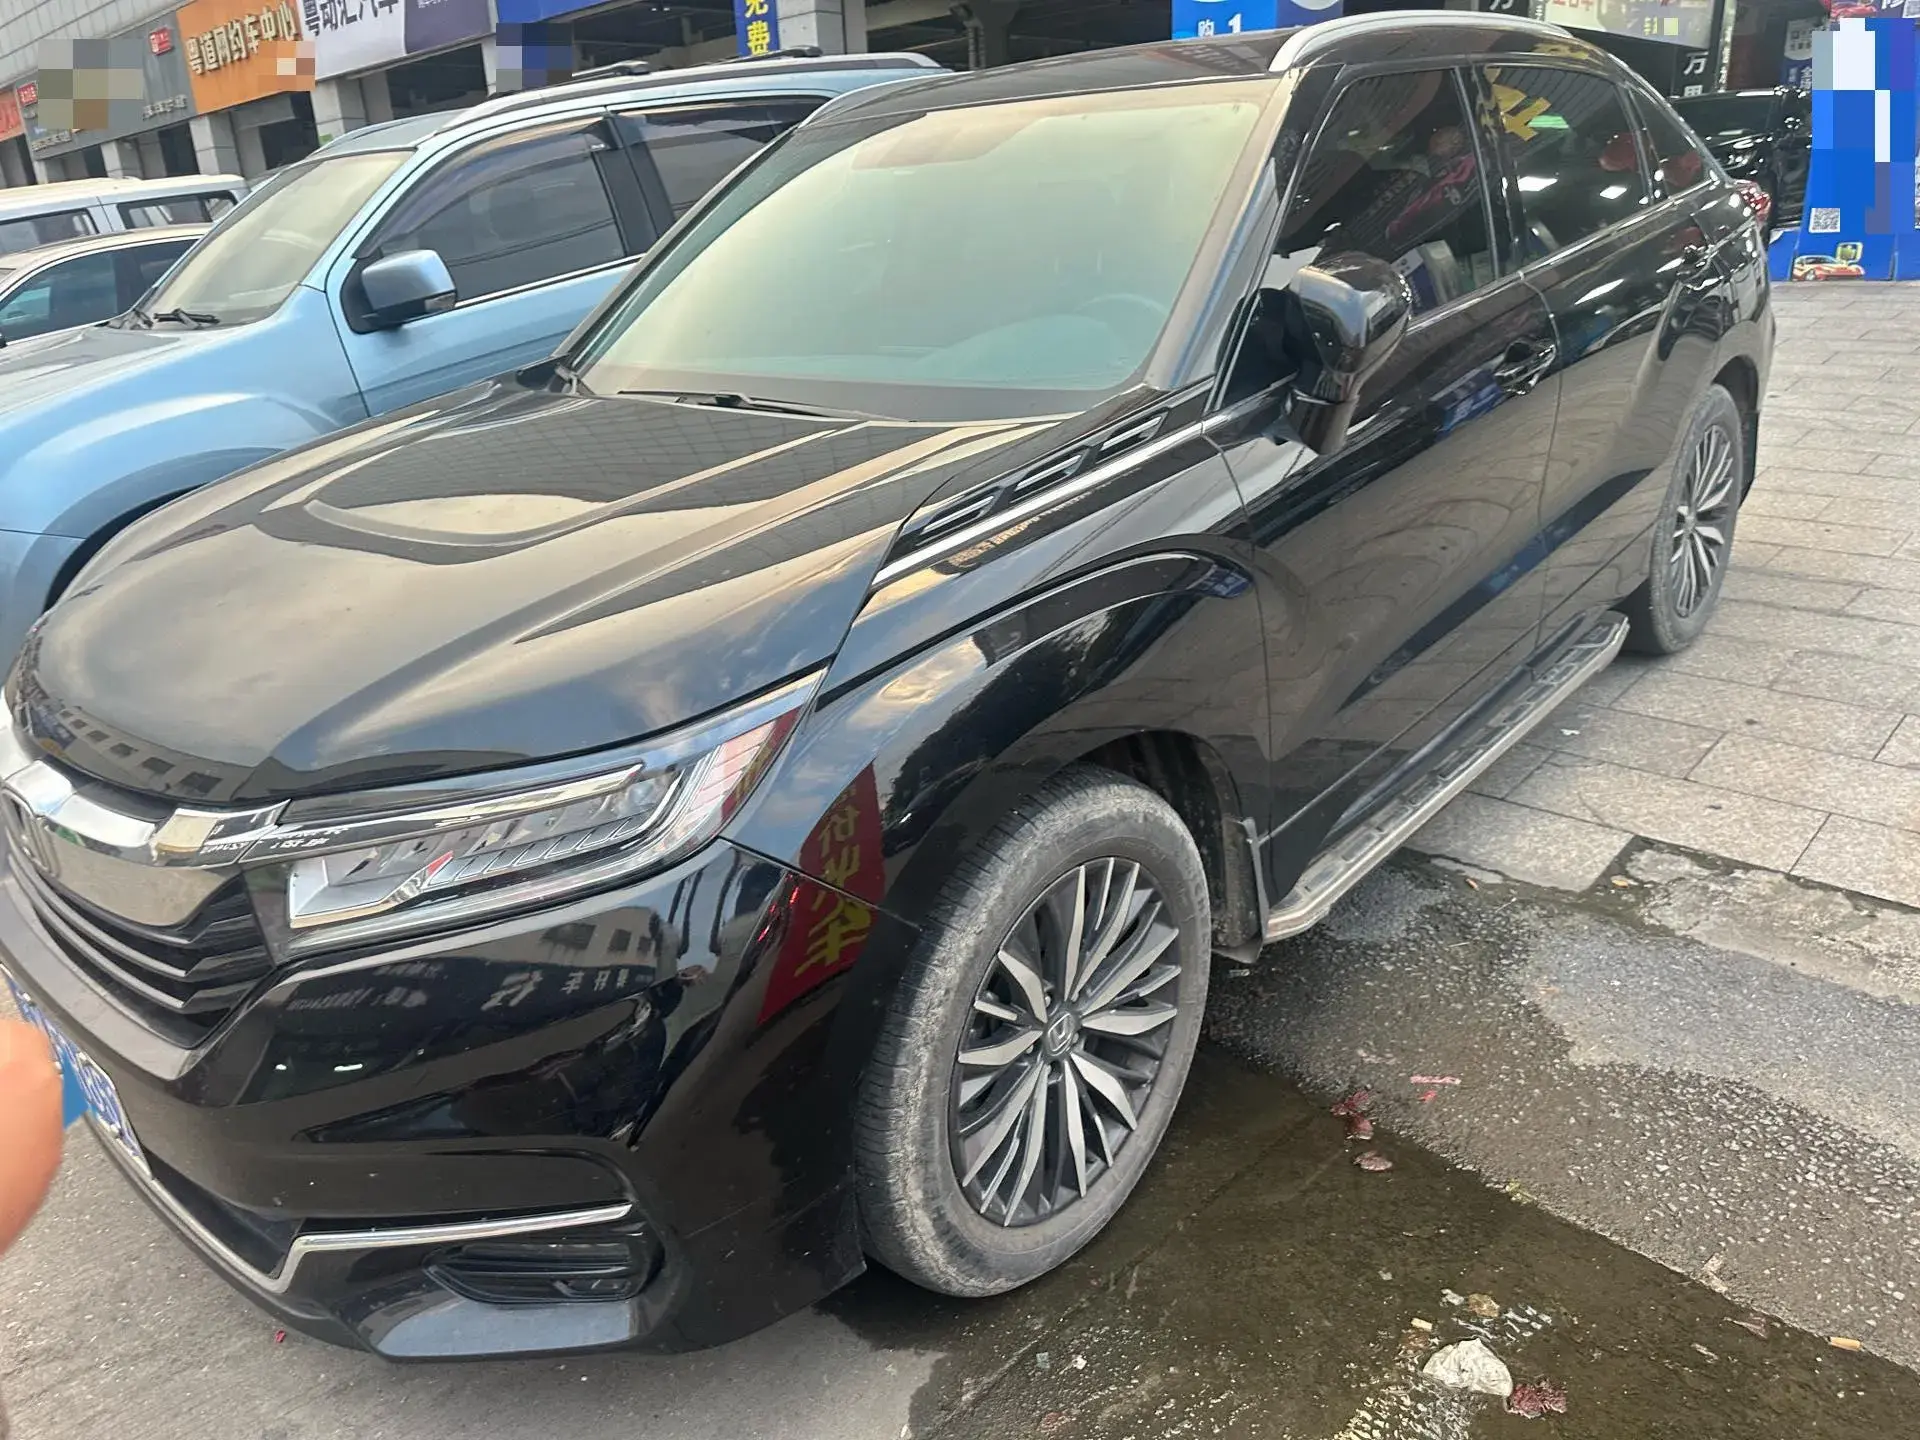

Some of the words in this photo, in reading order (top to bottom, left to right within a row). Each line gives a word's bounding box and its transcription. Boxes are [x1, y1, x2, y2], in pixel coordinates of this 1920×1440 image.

[185, 0, 299, 76] 粤道网约车中心
